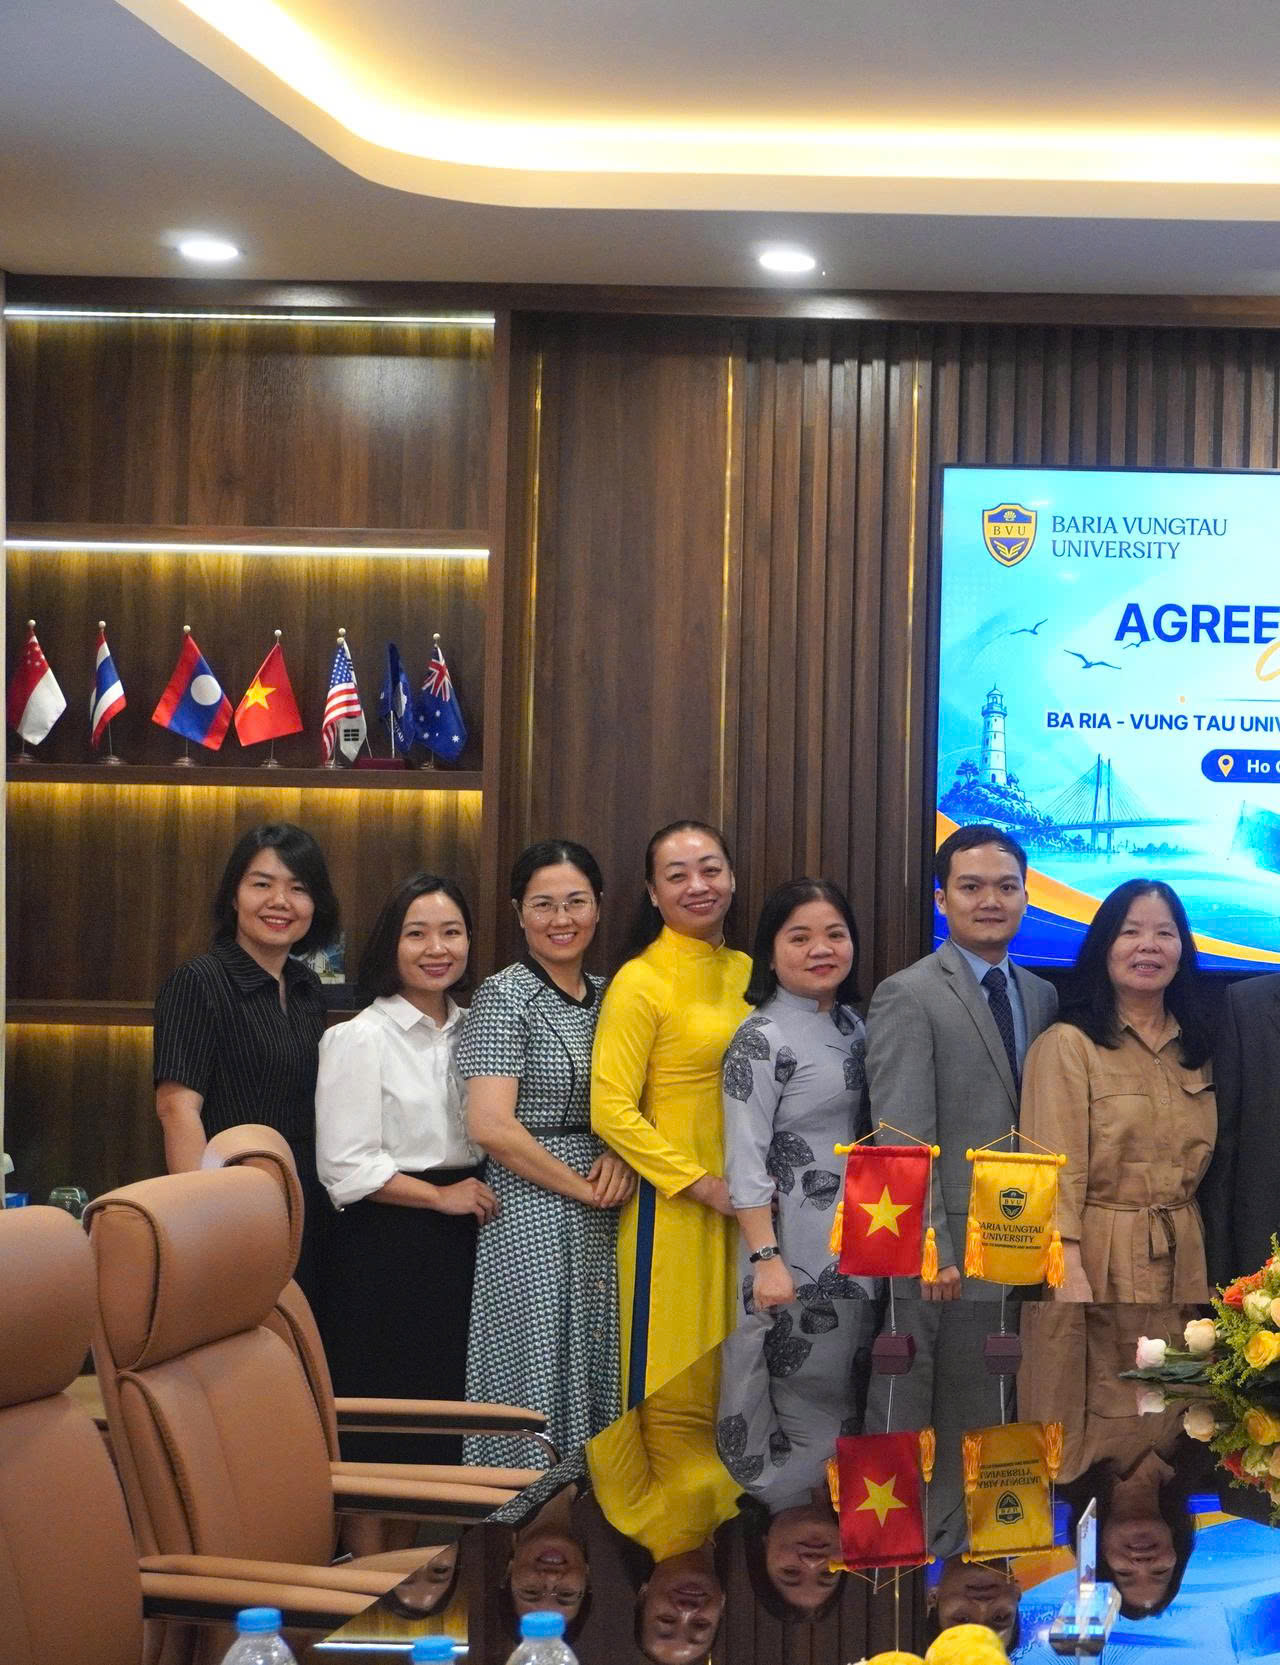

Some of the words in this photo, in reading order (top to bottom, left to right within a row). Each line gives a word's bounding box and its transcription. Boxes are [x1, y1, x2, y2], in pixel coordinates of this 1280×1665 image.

[1052, 515, 1118, 534] BARIA
[1123, 516, 1228, 536] VUNGTAU
[1052, 539, 1181, 560] UNIVERSITY
[1047, 712, 1075, 729] BA
[1079, 712, 1111, 729] RIA
[1130, 713, 1188, 731] VUNG
[1193, 714, 1235, 732] TAU
[1247, 759, 1270, 774] Ho
[979, 1222, 1001, 1232] ARIA
[1003, 1224, 1044, 1234] VUNGTAU
[982, 1232, 1035, 1243] UNIVERSITY
